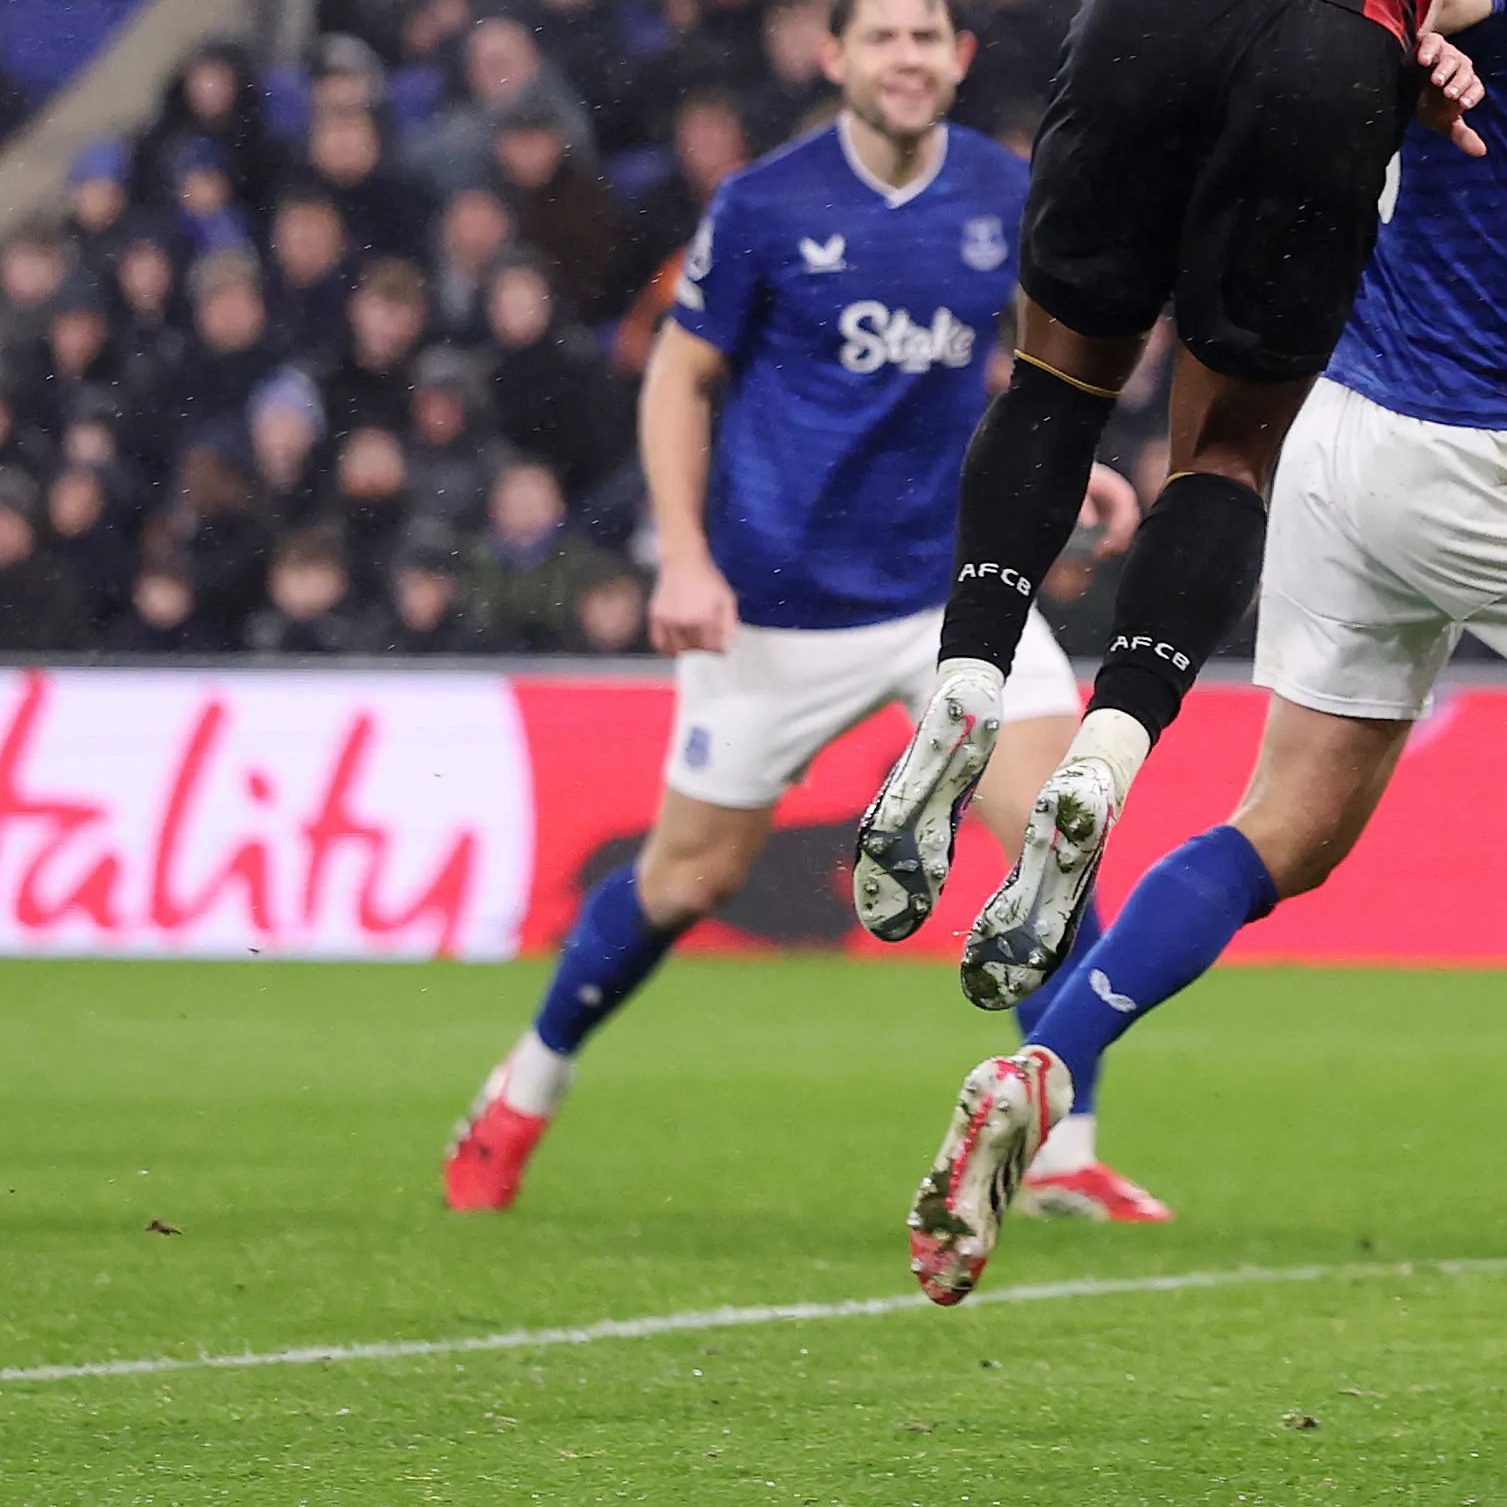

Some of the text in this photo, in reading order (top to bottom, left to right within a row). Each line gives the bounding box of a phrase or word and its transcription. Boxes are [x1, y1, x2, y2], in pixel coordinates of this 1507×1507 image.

[839, 299, 976, 374] Stake
[957, 562, 1032, 597] AFCB
[1109, 635, 1191, 672] AFCB
